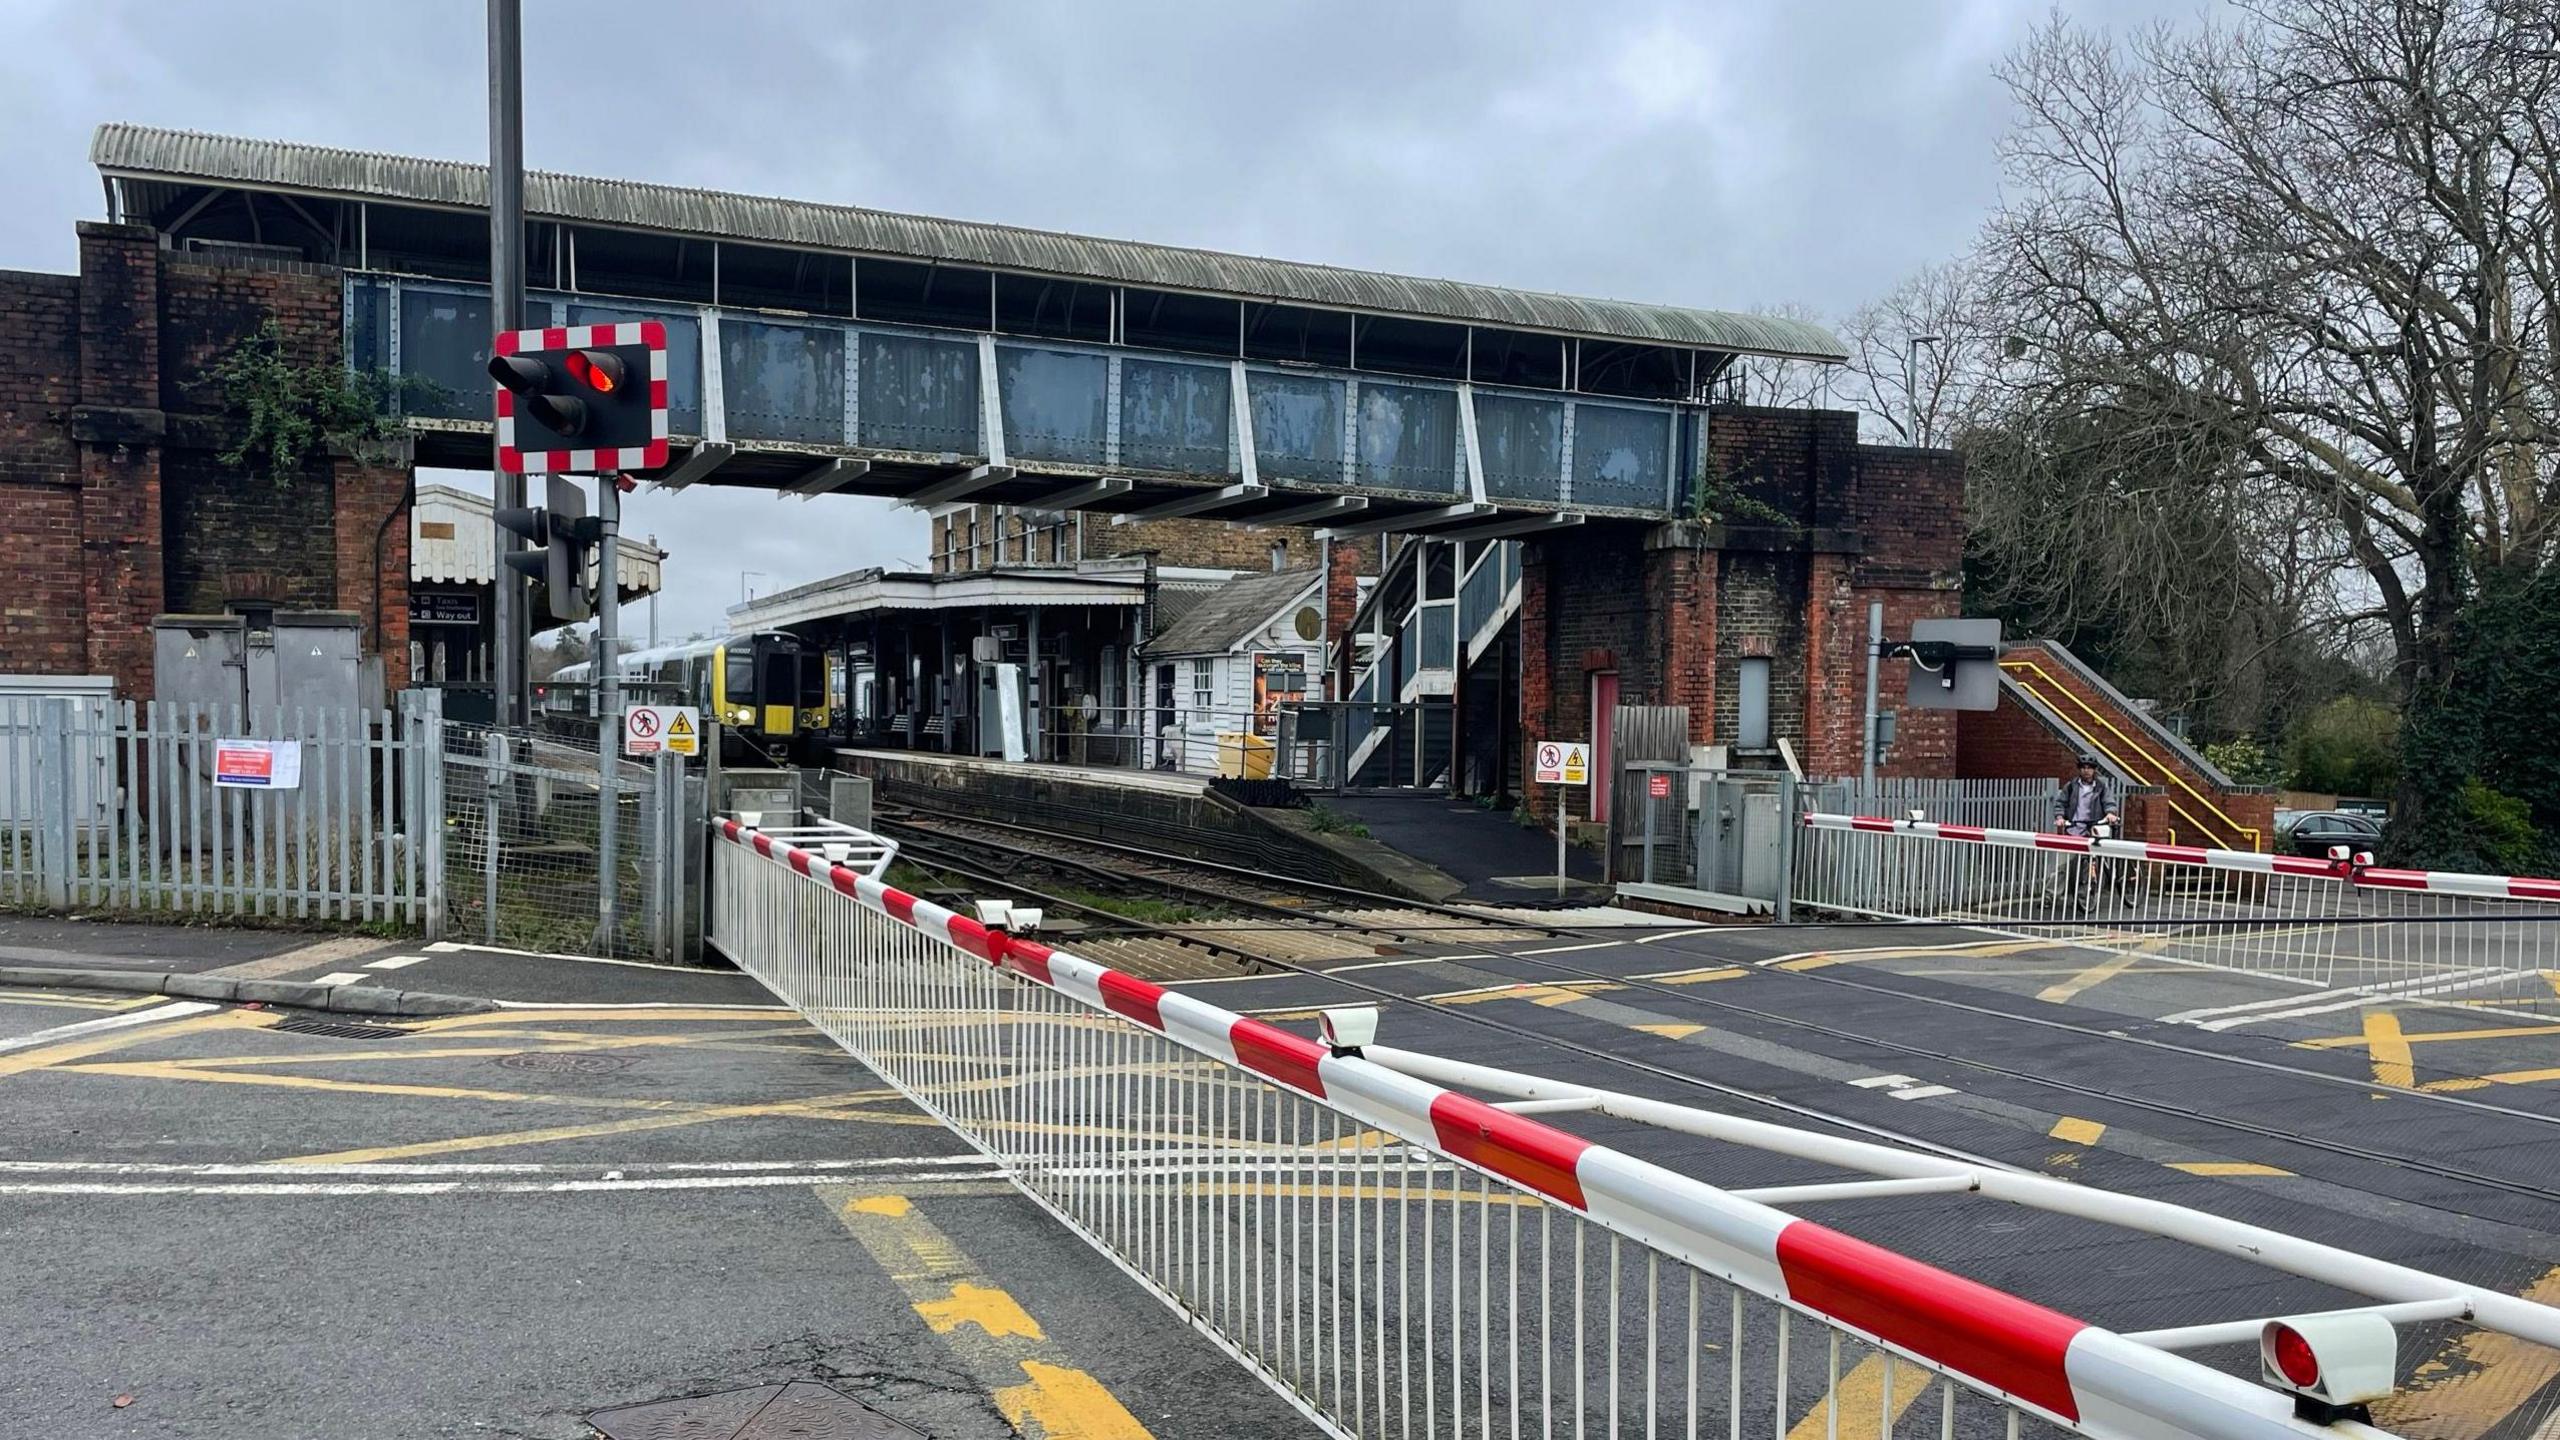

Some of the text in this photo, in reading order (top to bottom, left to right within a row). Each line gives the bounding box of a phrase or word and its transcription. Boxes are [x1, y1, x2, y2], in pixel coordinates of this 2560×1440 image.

[436, 596, 459, 605] Taxis
[436, 610, 471, 621] Way out
